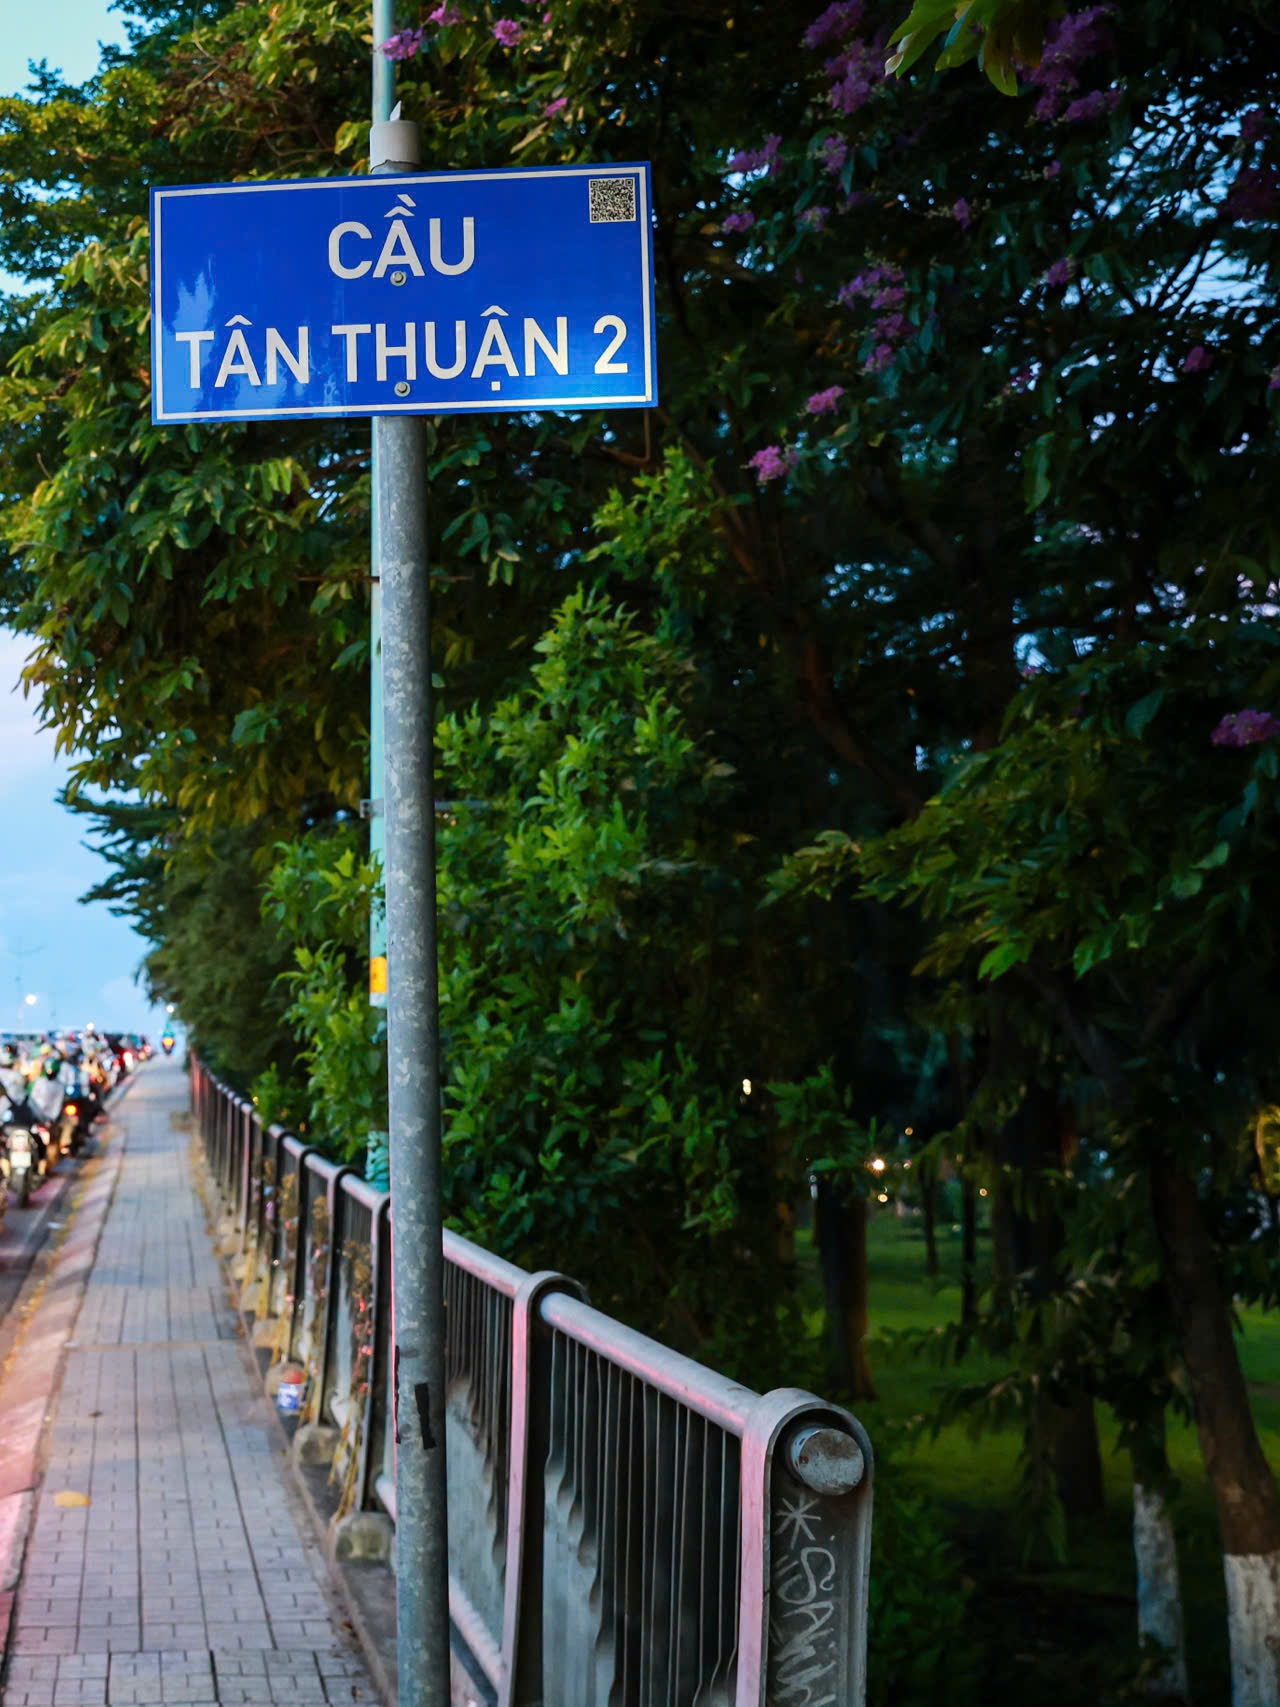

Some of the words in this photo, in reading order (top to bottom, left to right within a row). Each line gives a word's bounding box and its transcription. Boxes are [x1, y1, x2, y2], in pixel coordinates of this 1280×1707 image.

[328, 193, 476, 280] CẦU
[175, 314, 310, 389] TÂN
[332, 304, 569, 391] THUẬN
[593, 314, 629, 375] 2
